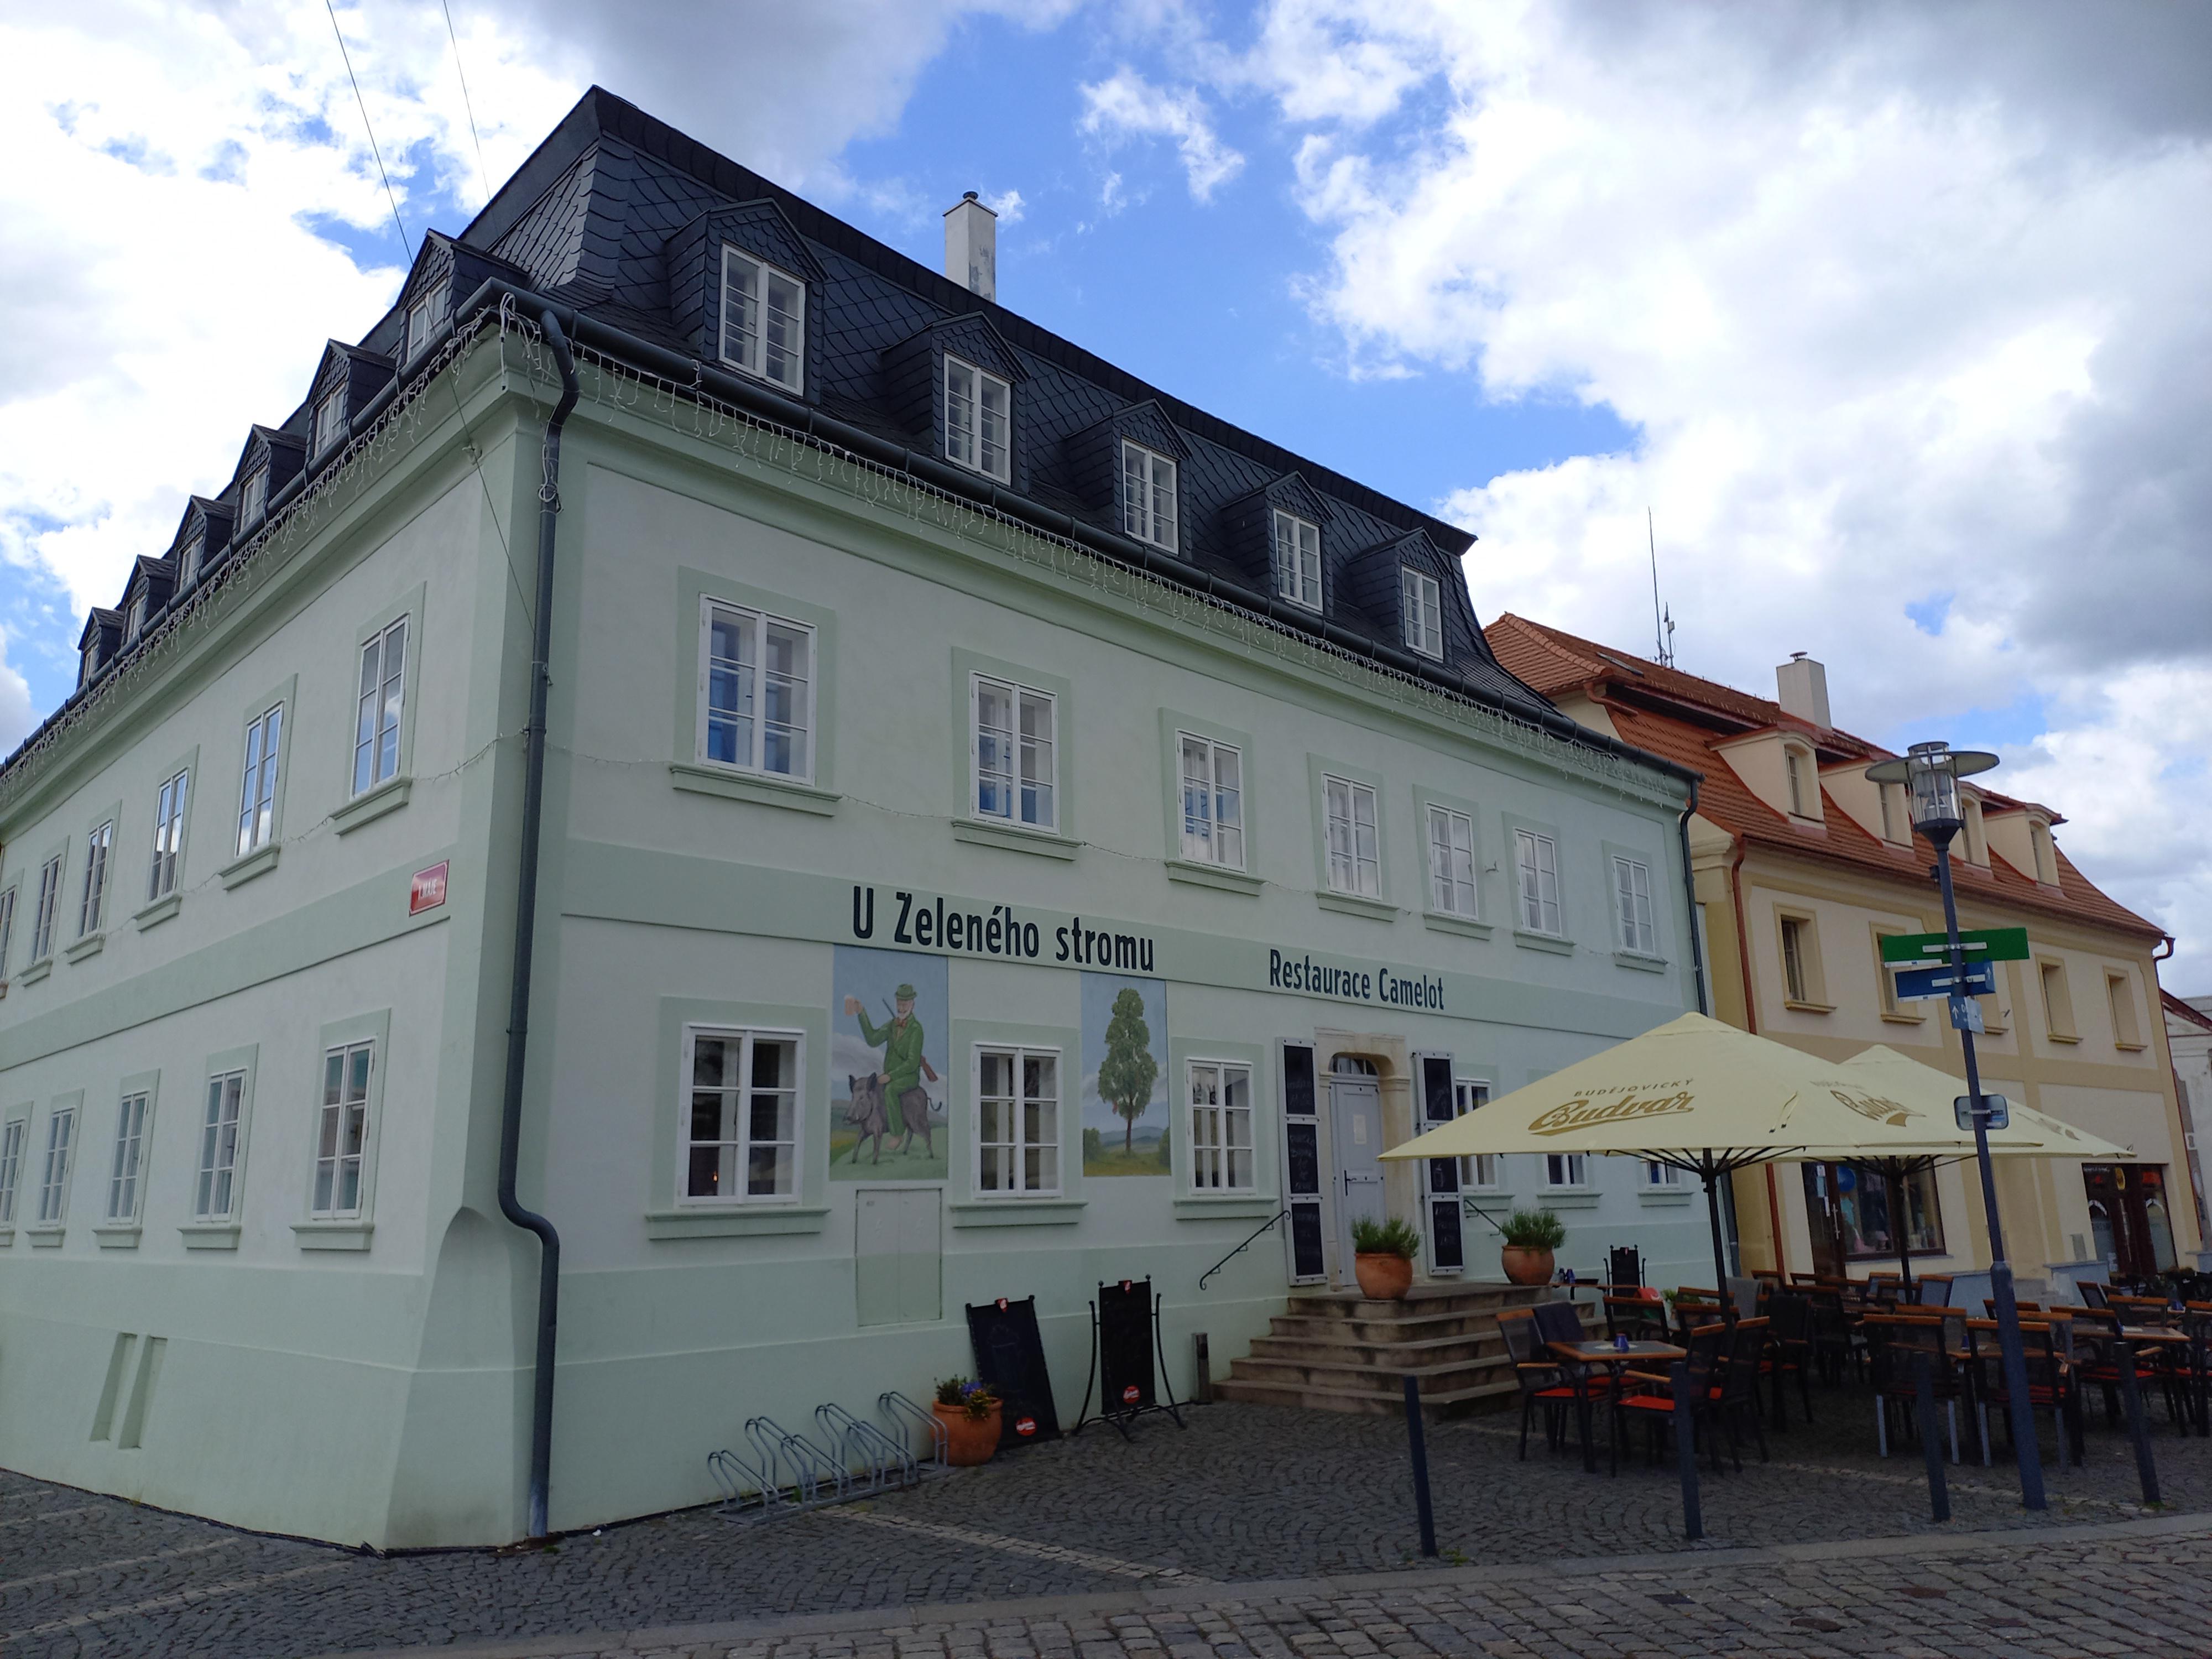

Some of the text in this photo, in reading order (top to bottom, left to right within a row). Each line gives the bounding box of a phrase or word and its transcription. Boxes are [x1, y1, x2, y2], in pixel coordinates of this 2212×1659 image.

[853, 885, 1154, 972] U Zeleného stromu
[1270, 948, 1444, 1011] Restaurace Camelot
[1528, 1091, 1694, 1131] Budvar
